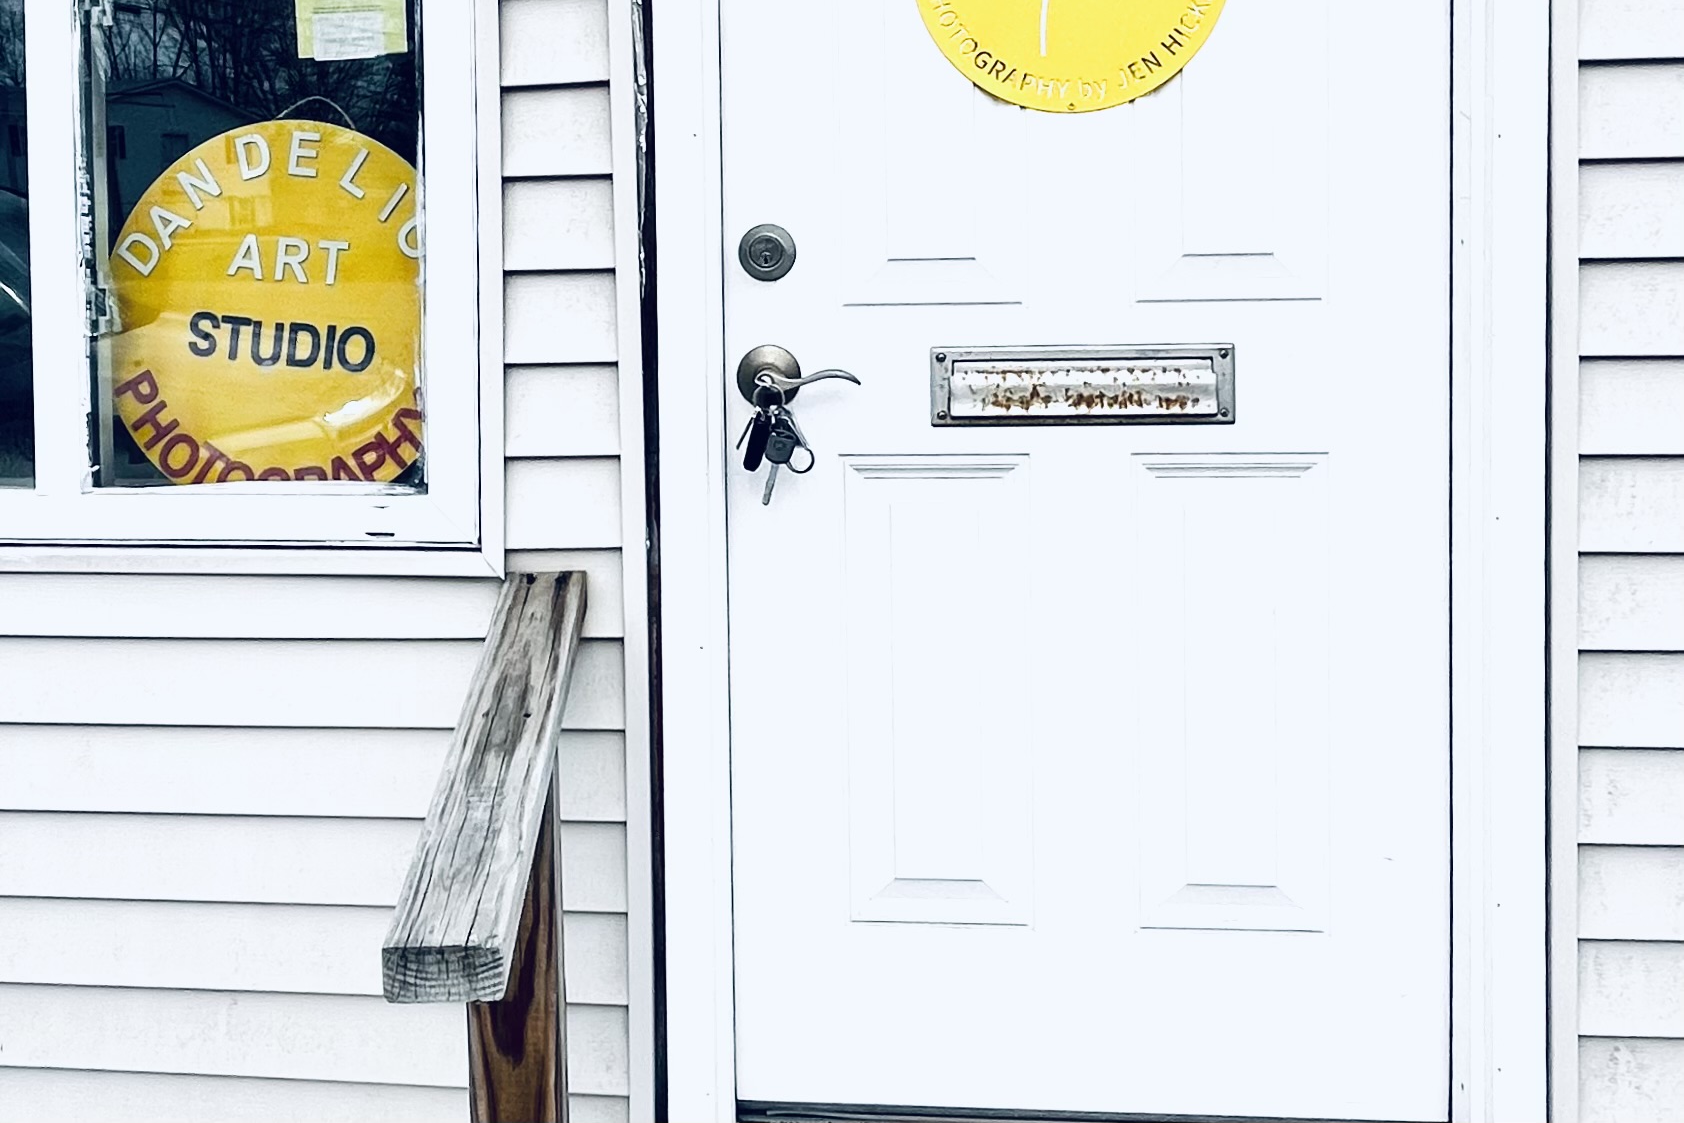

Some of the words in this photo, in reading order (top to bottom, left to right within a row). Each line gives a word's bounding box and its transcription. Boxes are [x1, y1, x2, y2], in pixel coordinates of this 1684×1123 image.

[1118, 50, 1162, 90] JEN
[227, 233, 349, 286] ART
[188, 312, 375, 372] STUDIO
